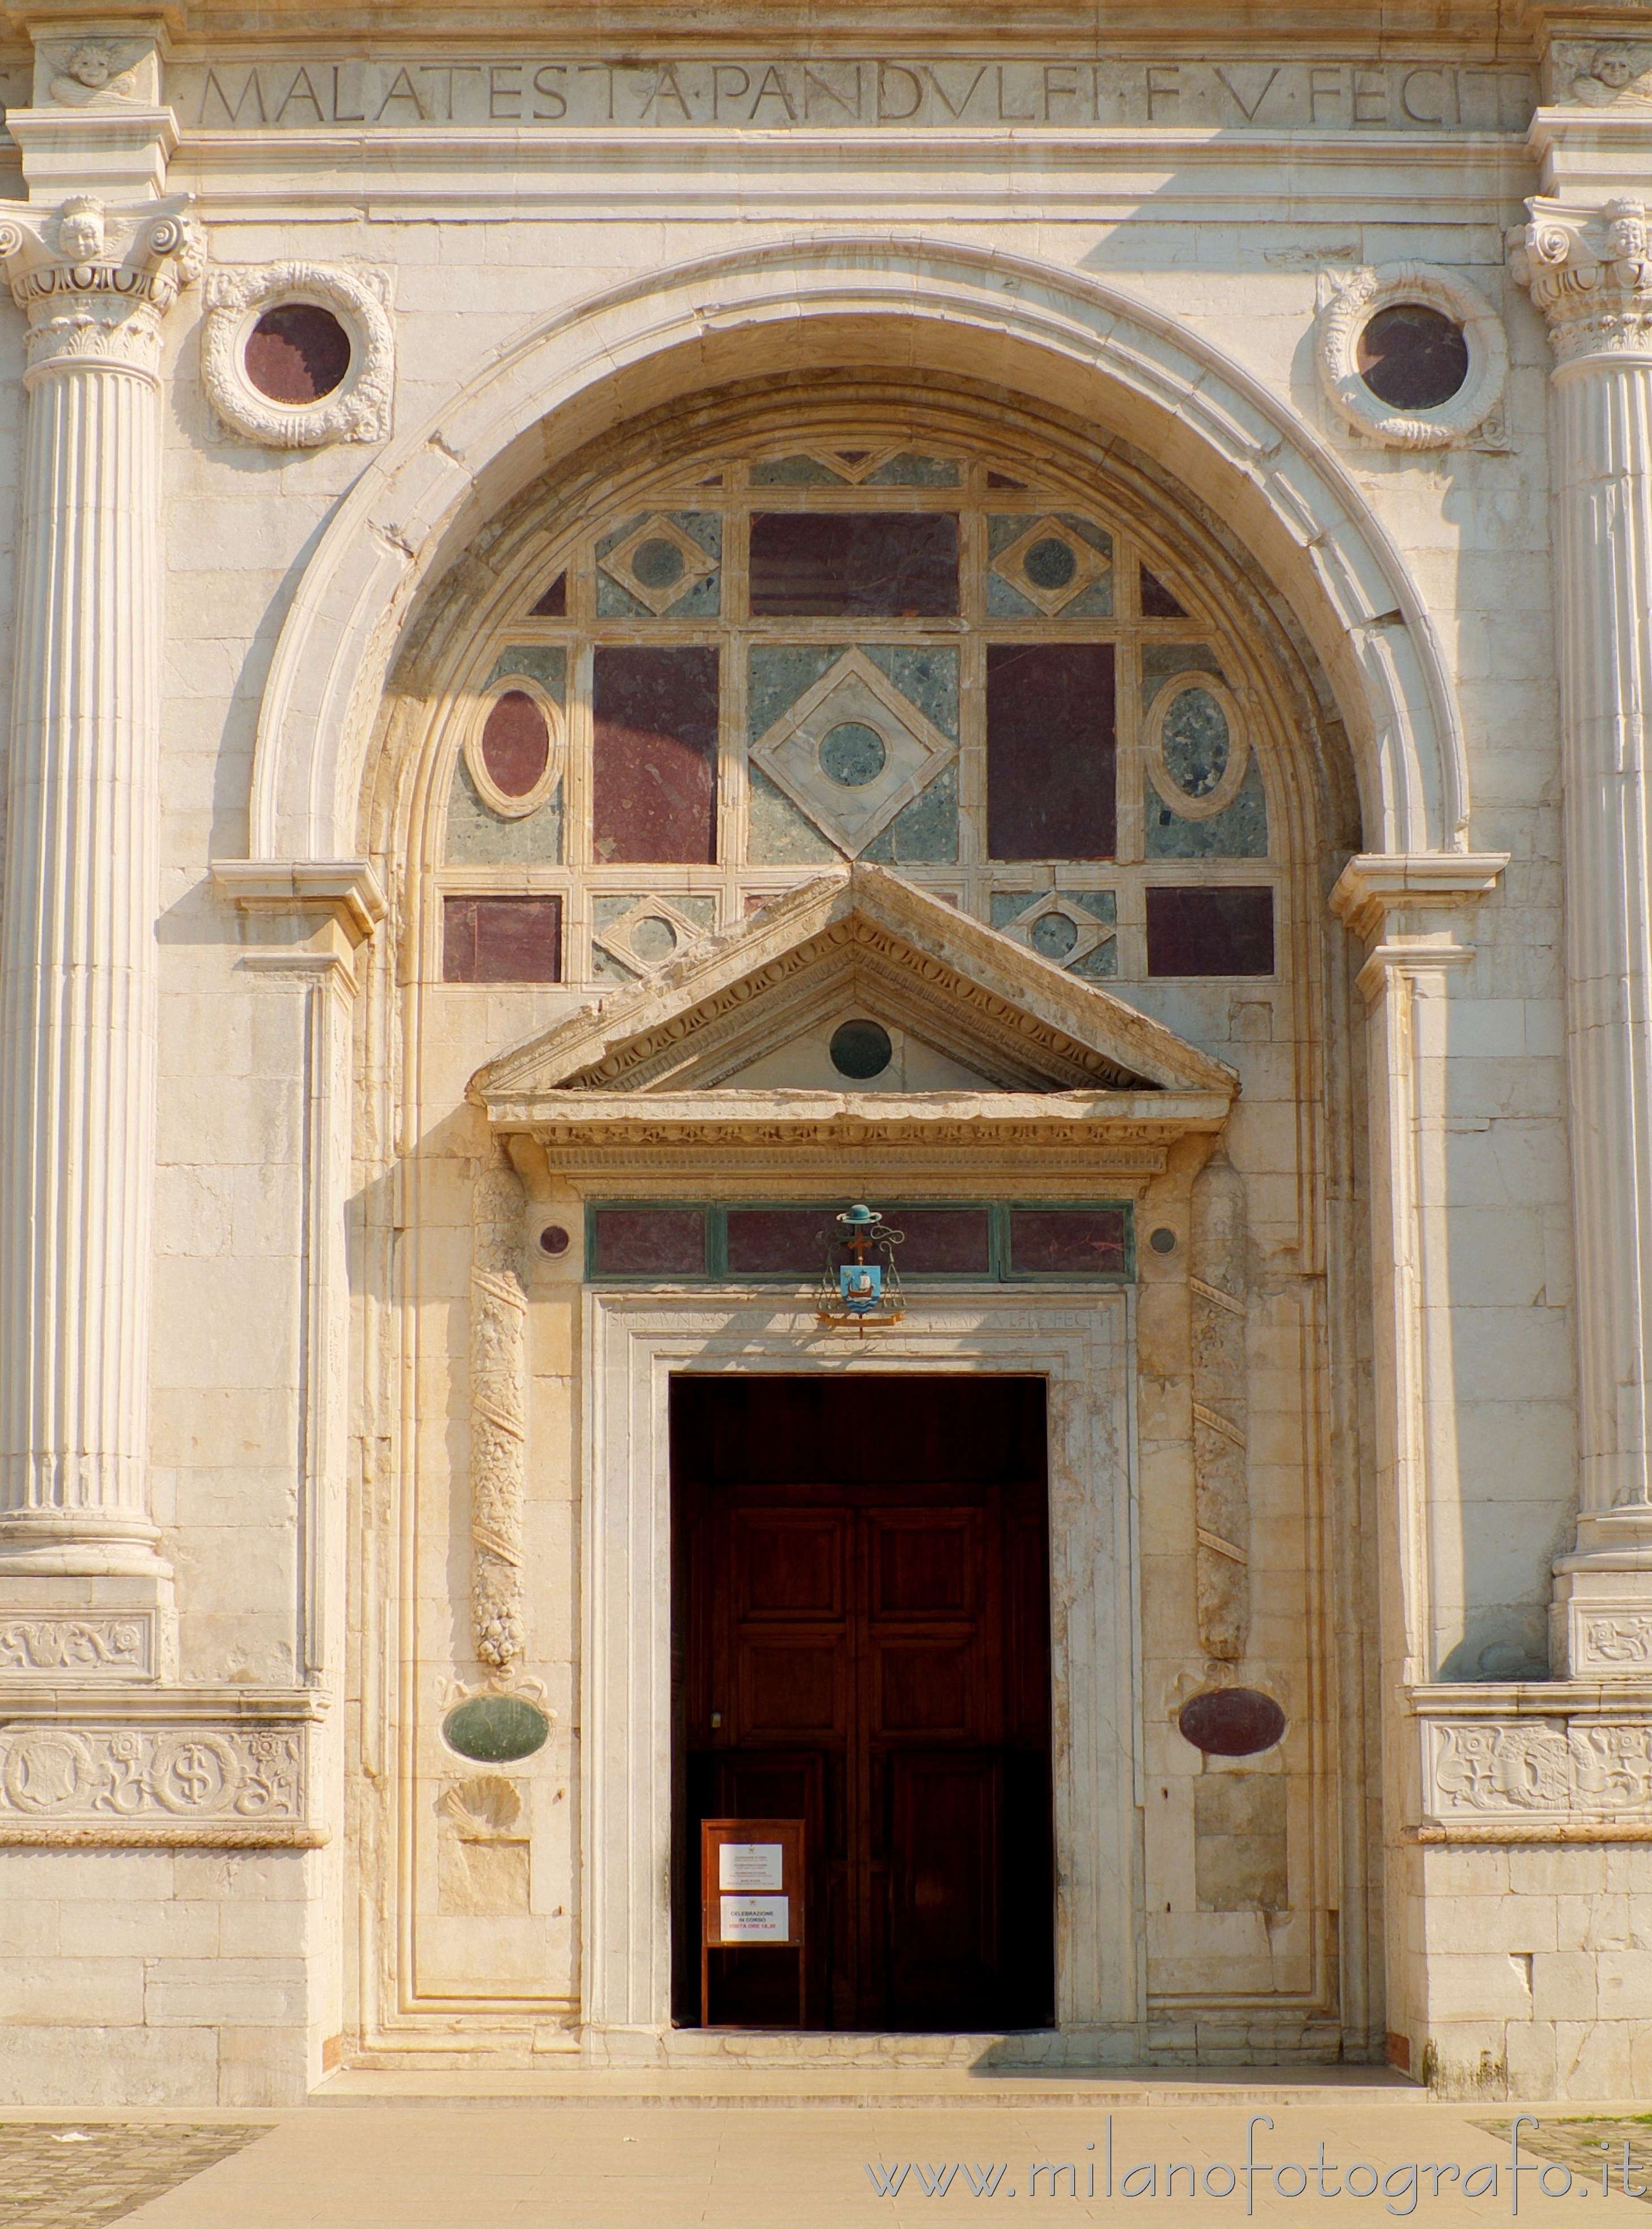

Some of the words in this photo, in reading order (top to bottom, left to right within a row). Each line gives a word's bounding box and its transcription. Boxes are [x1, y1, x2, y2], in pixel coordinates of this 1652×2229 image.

[712, 65, 1100, 121] PANDVLFI
[1145, 66, 1180, 121] F
[1212, 67, 1281, 122] V
